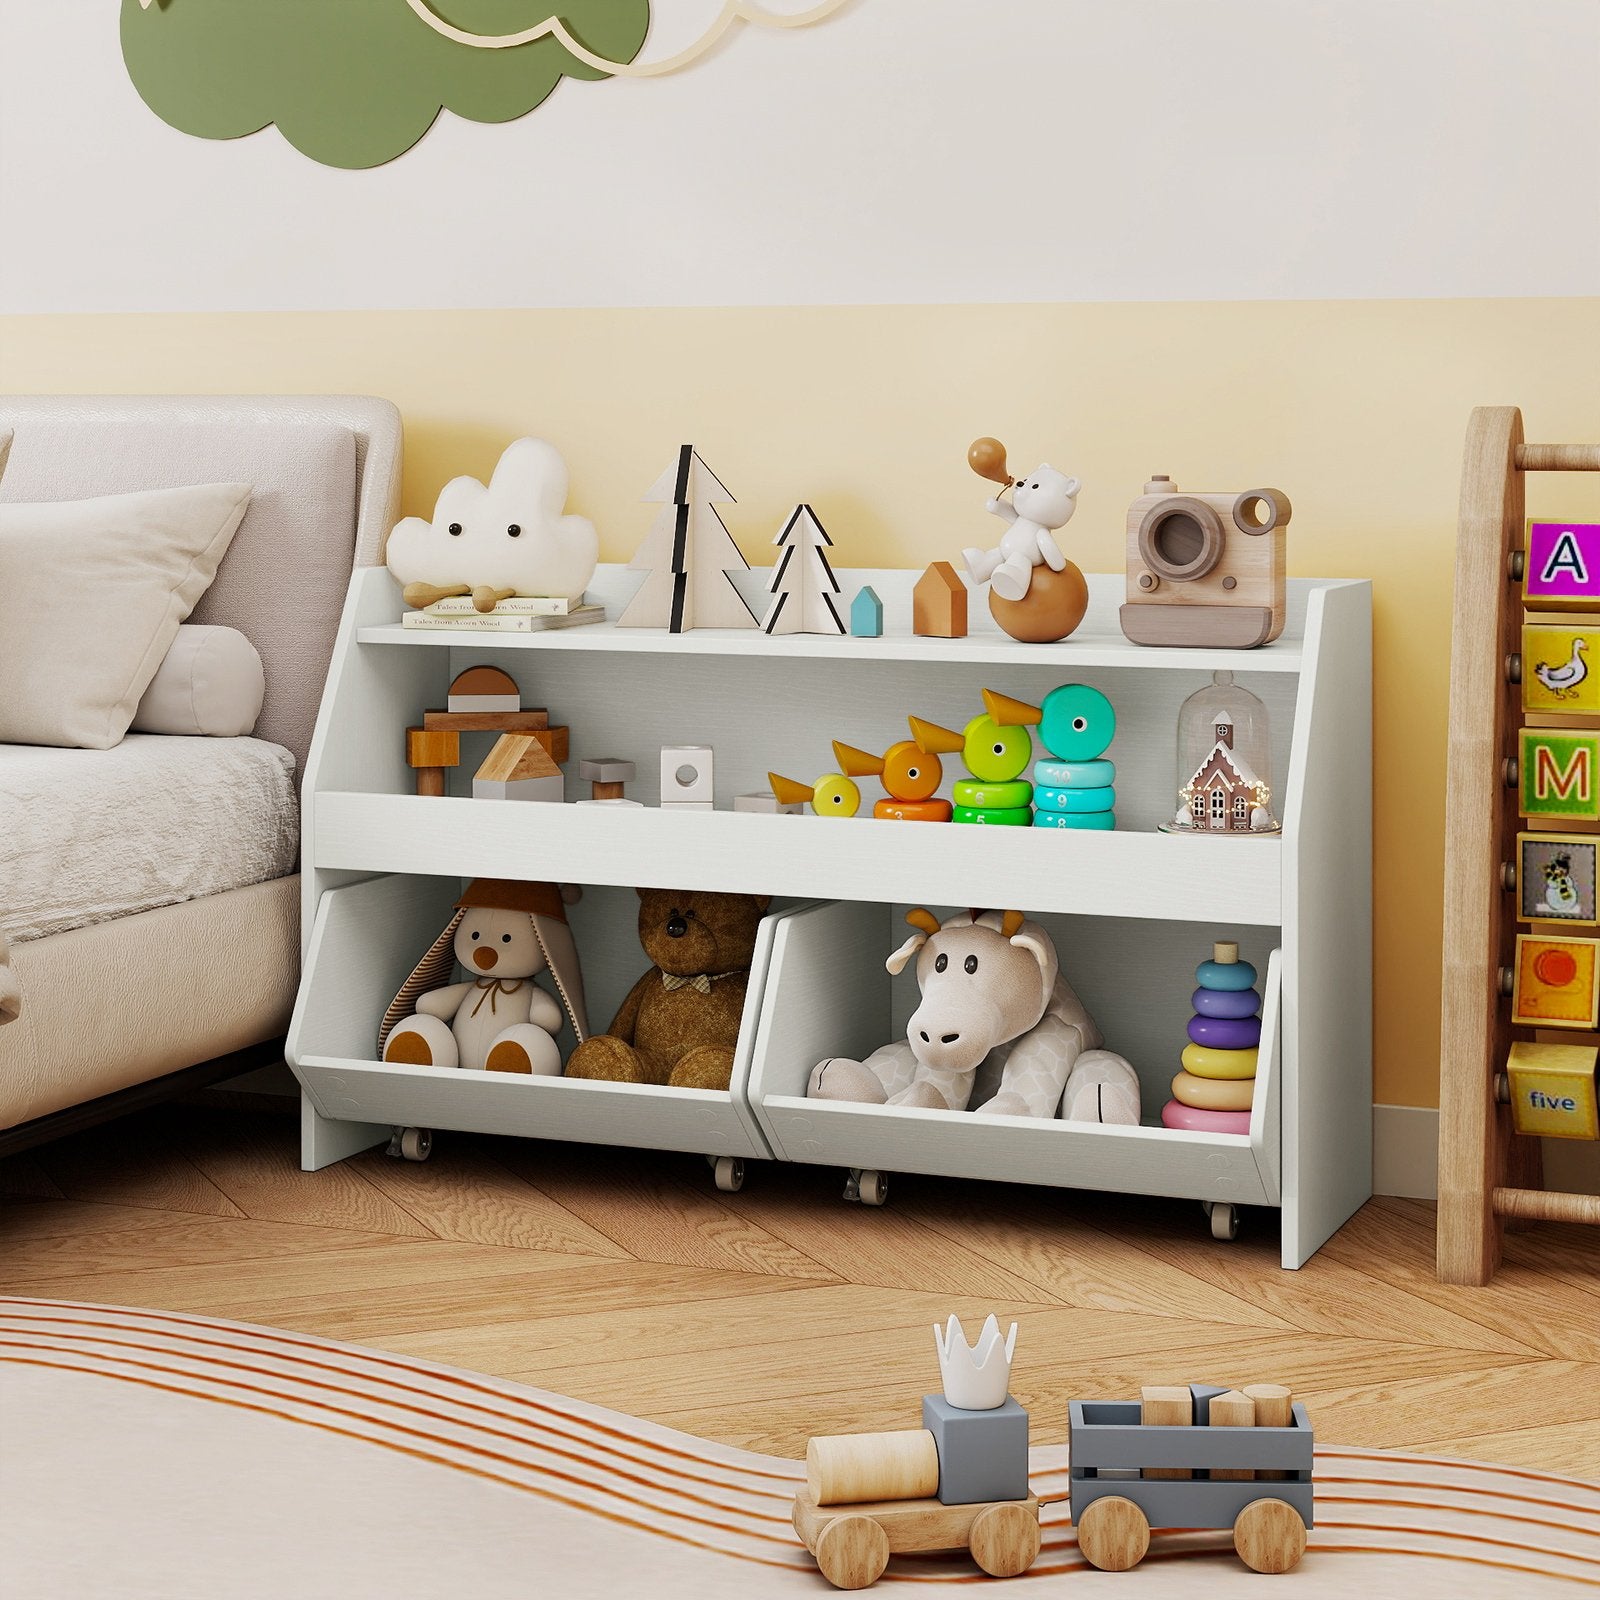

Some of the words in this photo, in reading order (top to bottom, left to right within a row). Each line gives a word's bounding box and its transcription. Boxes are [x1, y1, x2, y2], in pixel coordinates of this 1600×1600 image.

[1541, 532, 1588, 583] A
[1053, 769, 1071, 783] 10
[1536, 746, 1590, 801] M
[976, 791, 985, 805] 6
[1057, 793, 1068, 808] 9
[976, 814, 986, 825] 5
[1057, 817, 1067, 829] 8
[1530, 1090, 1576, 1111] five
